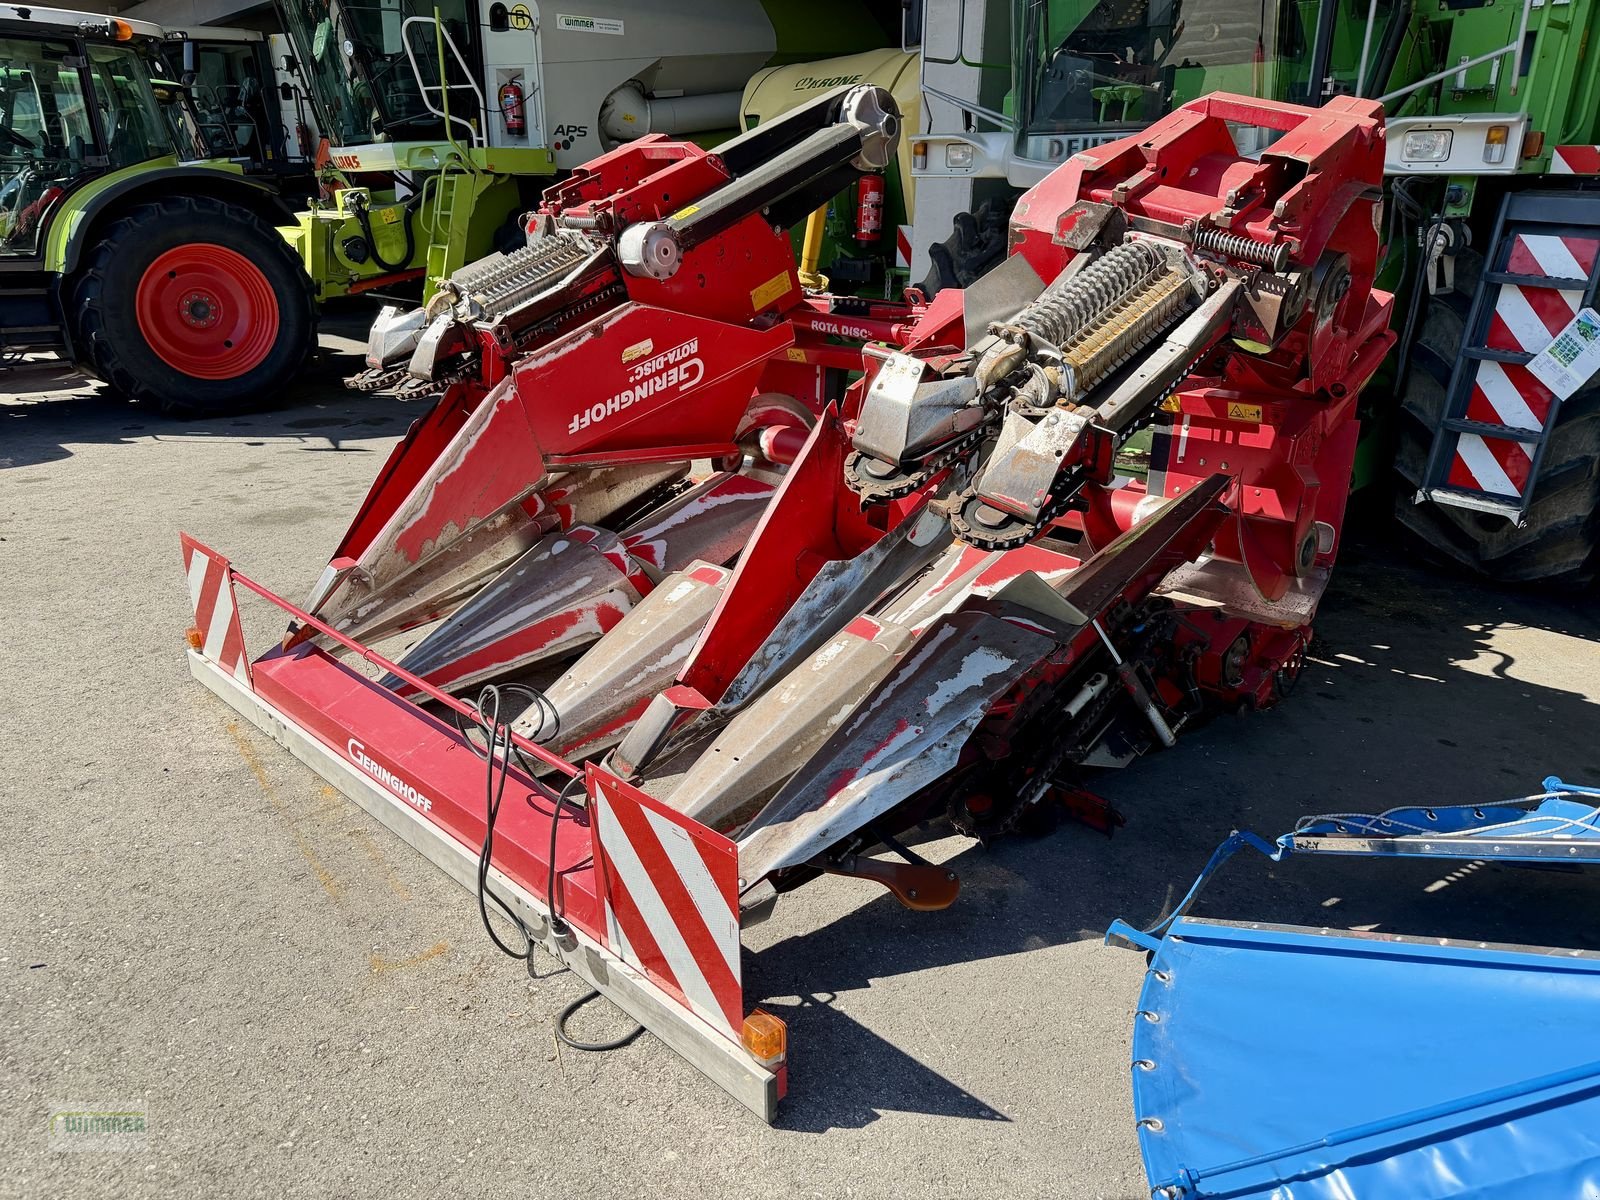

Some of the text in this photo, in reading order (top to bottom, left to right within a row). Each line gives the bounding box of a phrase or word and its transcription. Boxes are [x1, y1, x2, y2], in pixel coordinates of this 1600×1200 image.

[564, 18, 595, 29] WIMMER
[806, 74, 863, 90] KRONE
[553, 124, 588, 137] APS
[332, 155, 361, 169] CLAAS
[811, 320, 839, 334] ROTA
[568, 357, 705, 435] GERINGHOFF
[347, 738, 433, 813] GERINGHOFF
